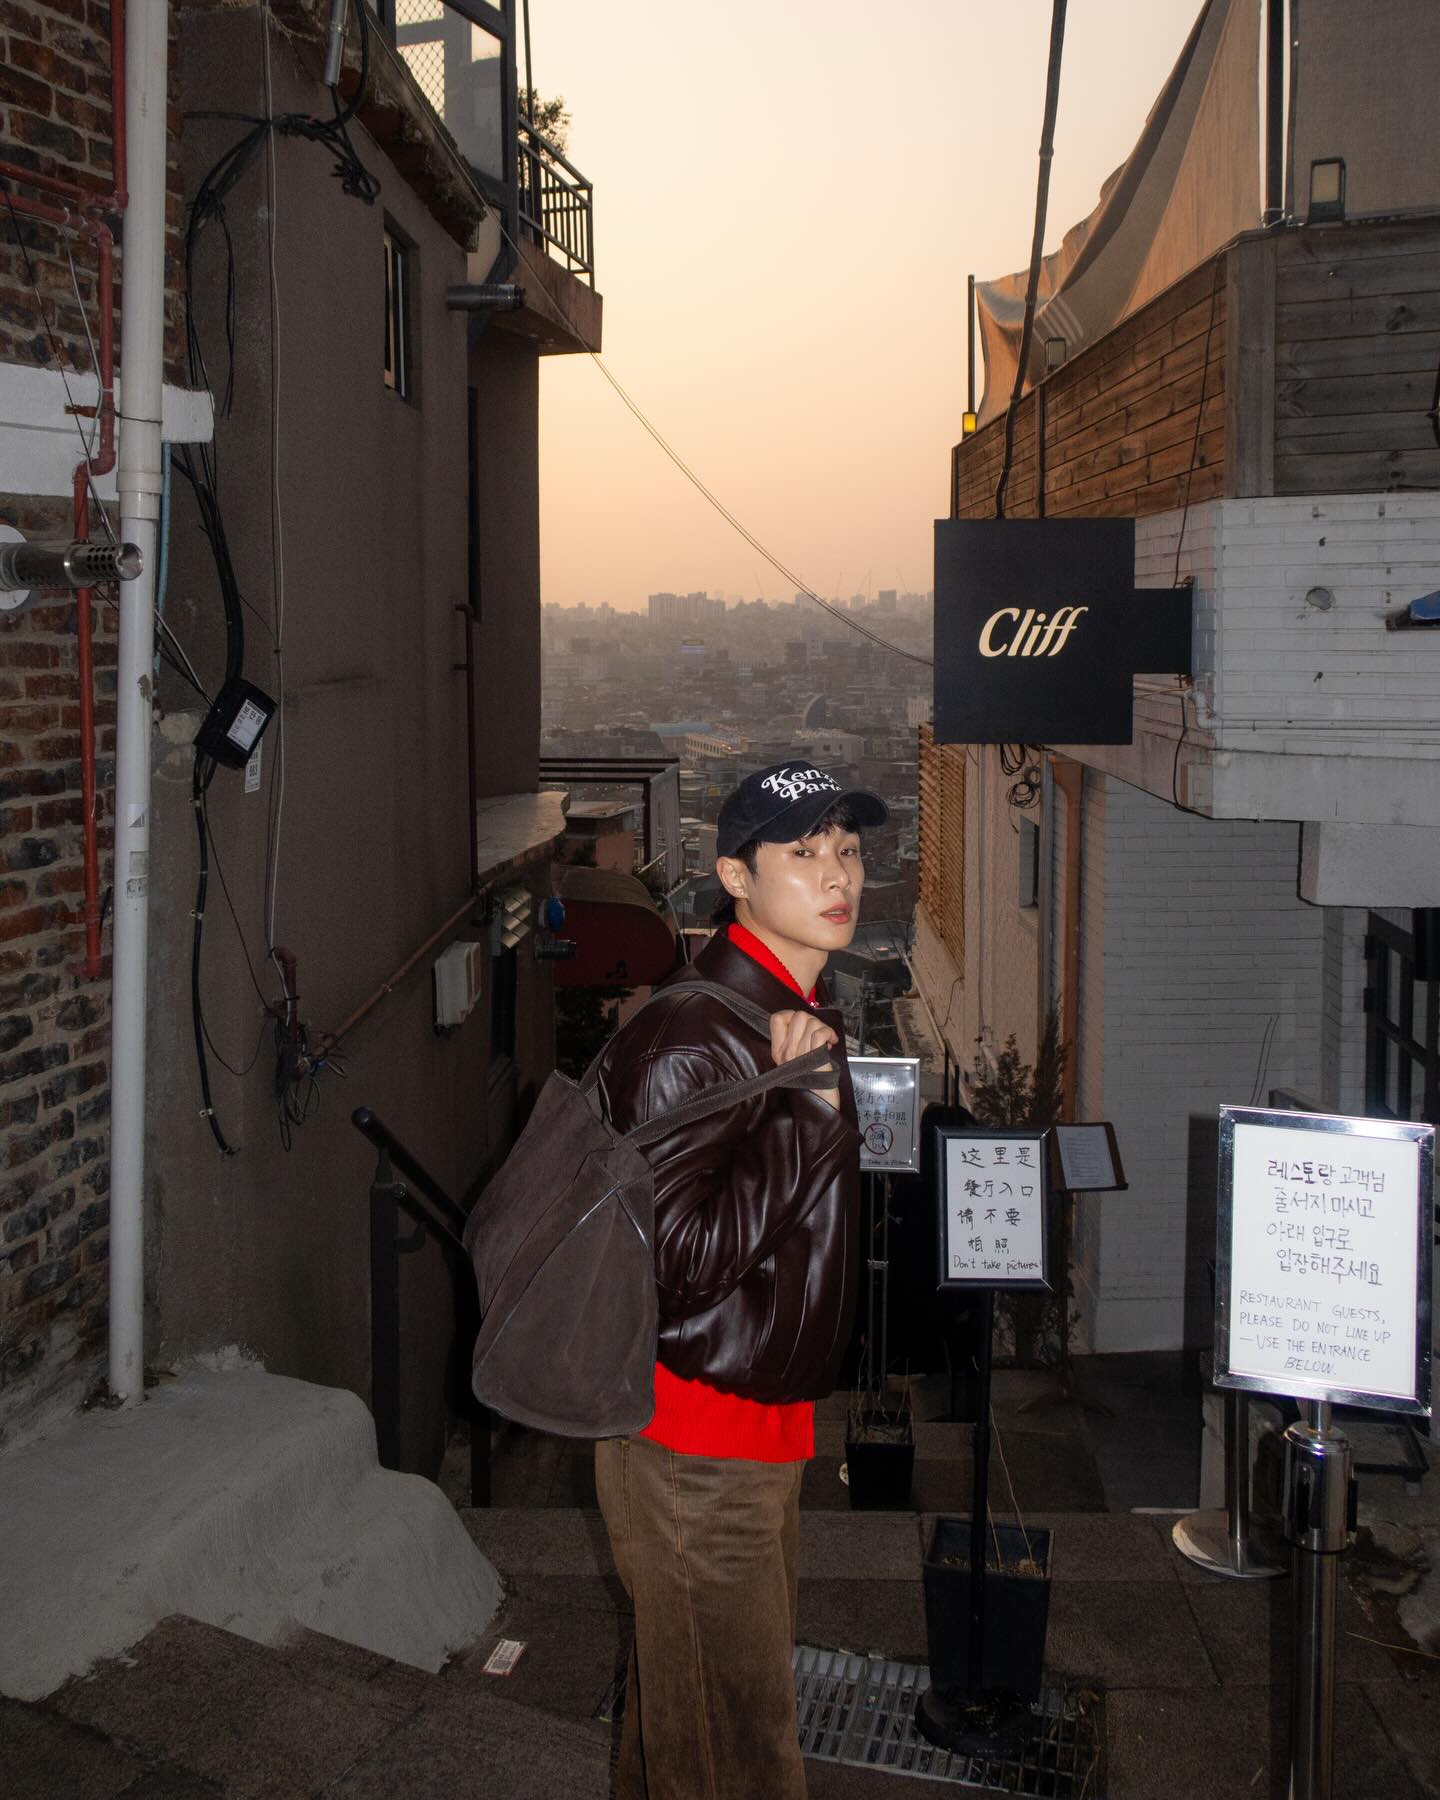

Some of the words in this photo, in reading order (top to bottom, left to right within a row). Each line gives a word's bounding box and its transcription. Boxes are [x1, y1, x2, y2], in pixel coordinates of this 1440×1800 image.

[979, 606, 1089, 657] Cliff
[961, 1147, 1036, 1168] 这里是
[1267, 1159, 1336, 1186] 레스토랑
[1339, 1166, 1385, 1192] 고객님
[1331, 1196, 1375, 1218] 마시고
[967, 1236, 1010, 1254] 拍照
[1266, 1220, 1305, 1241] 아래
[1312, 1224, 1354, 1251] 입구로
[953, 1254, 976, 1269] Don't
[981, 1259, 1001, 1270] take
[1276, 1248, 1383, 1285] 입장해주세요
[1240, 1289, 1321, 1312] RESTAURANT
[1332, 1304, 1385, 1325] GUESTS,
[1240, 1312, 1283, 1328] PLEASE
[1292, 1318, 1310, 1332] DO
[1317, 1321, 1339, 1337] NOT
[1345, 1326, 1369, 1341] LINE
[1374, 1330, 1391, 1344] UP
[1286, 1339, 1305, 1352] THE
[1312, 1341, 1371, 1362] ENTRANCE
